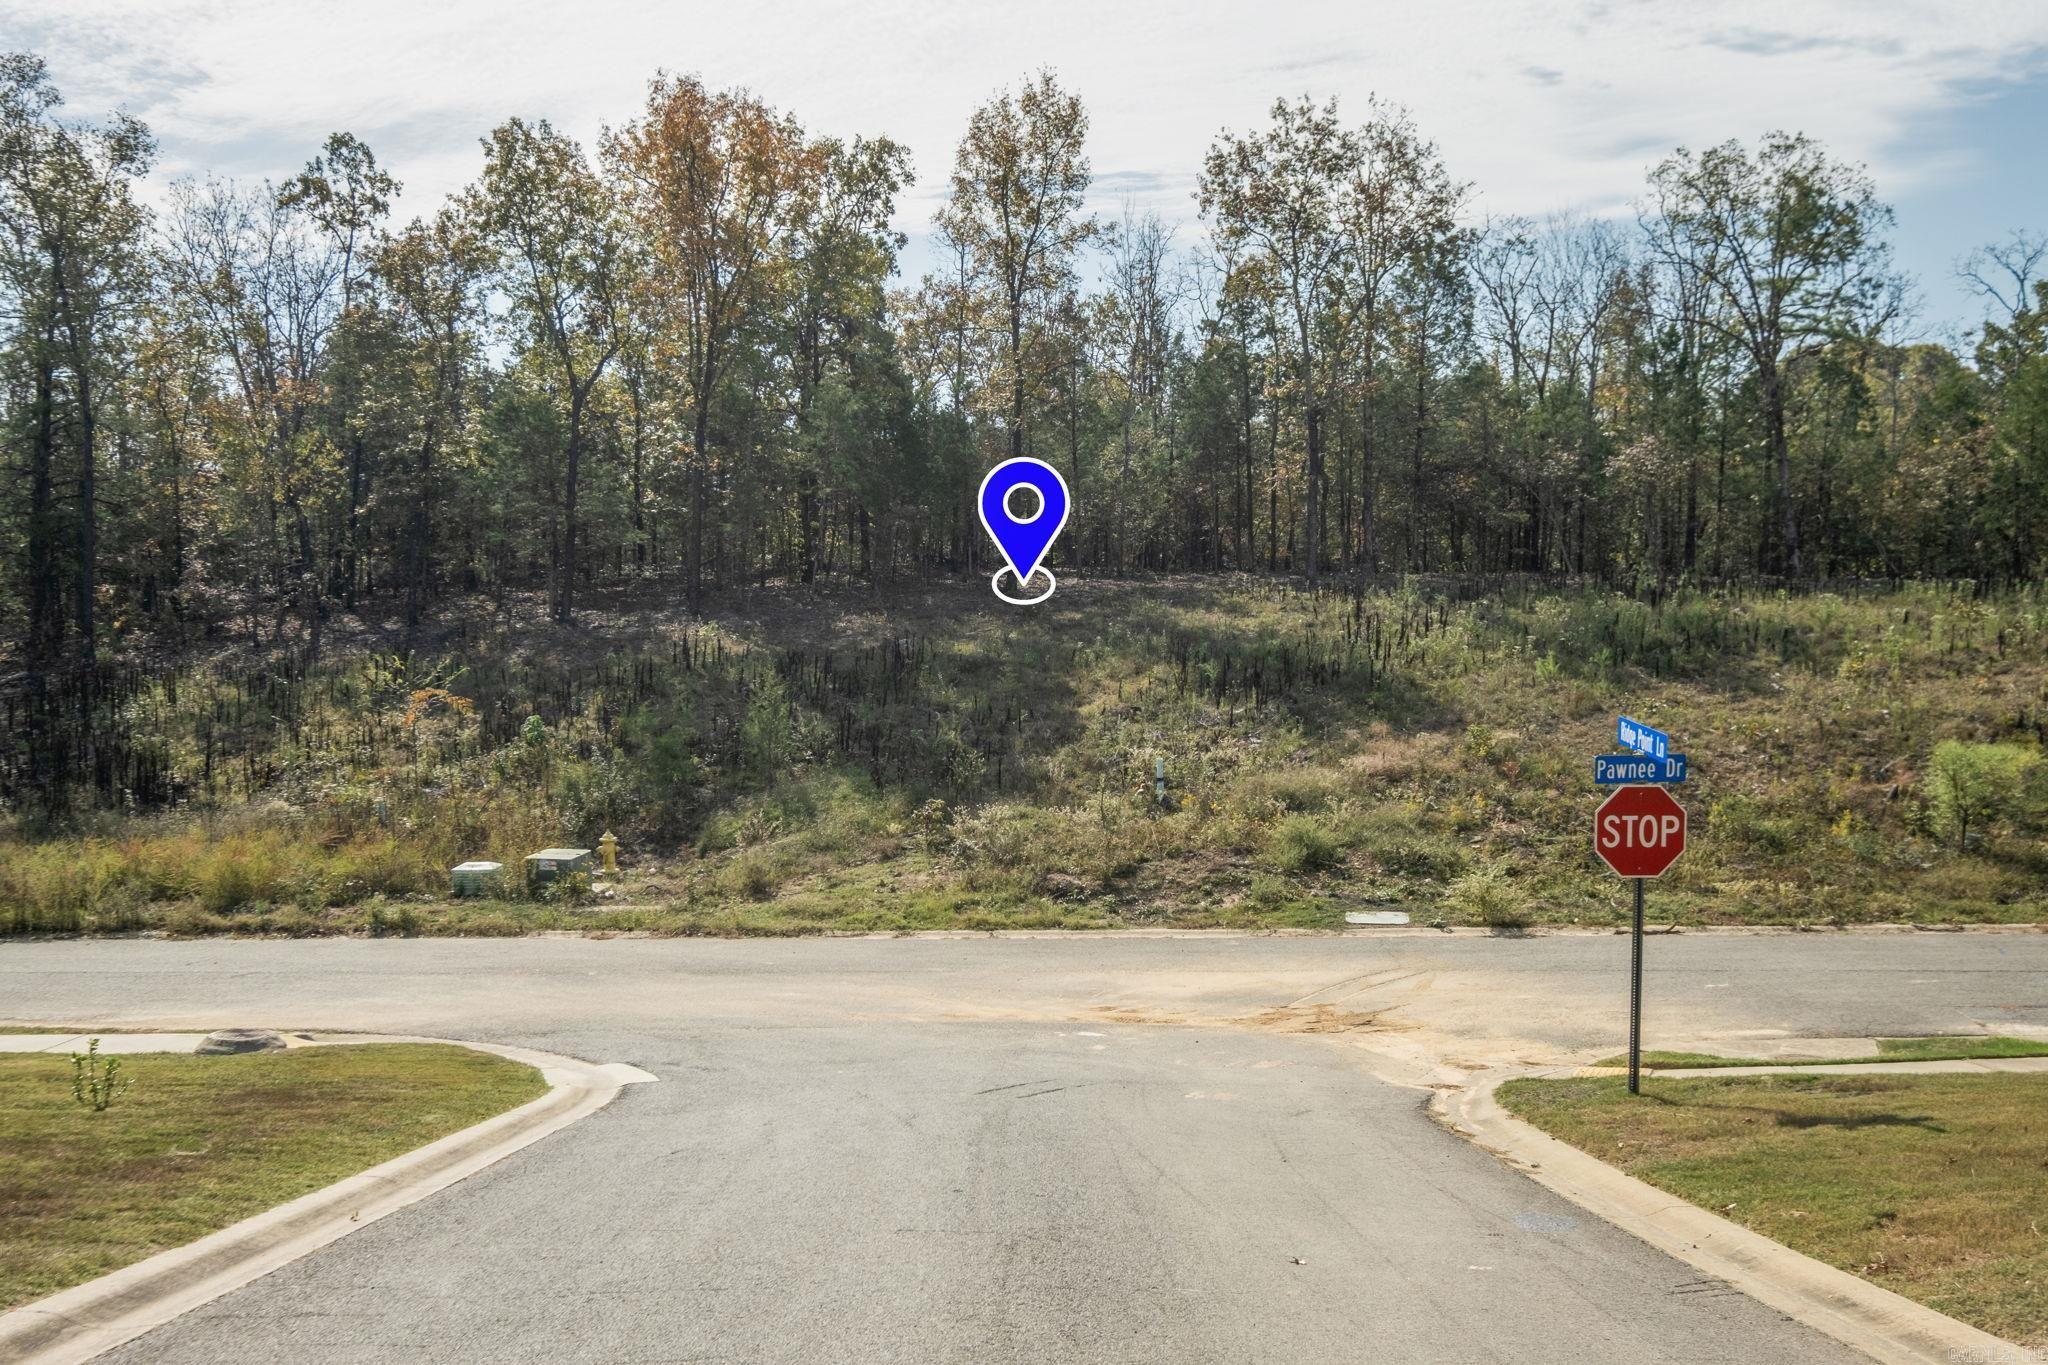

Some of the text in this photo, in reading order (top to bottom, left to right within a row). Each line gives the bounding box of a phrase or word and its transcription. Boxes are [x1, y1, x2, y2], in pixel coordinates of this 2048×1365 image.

[1637, 729, 1653, 753] Point
[1656, 737, 1664, 758] Ln
[1597, 758, 1684, 779] Pawnee Dr
[1602, 815, 1680, 848] STOP
